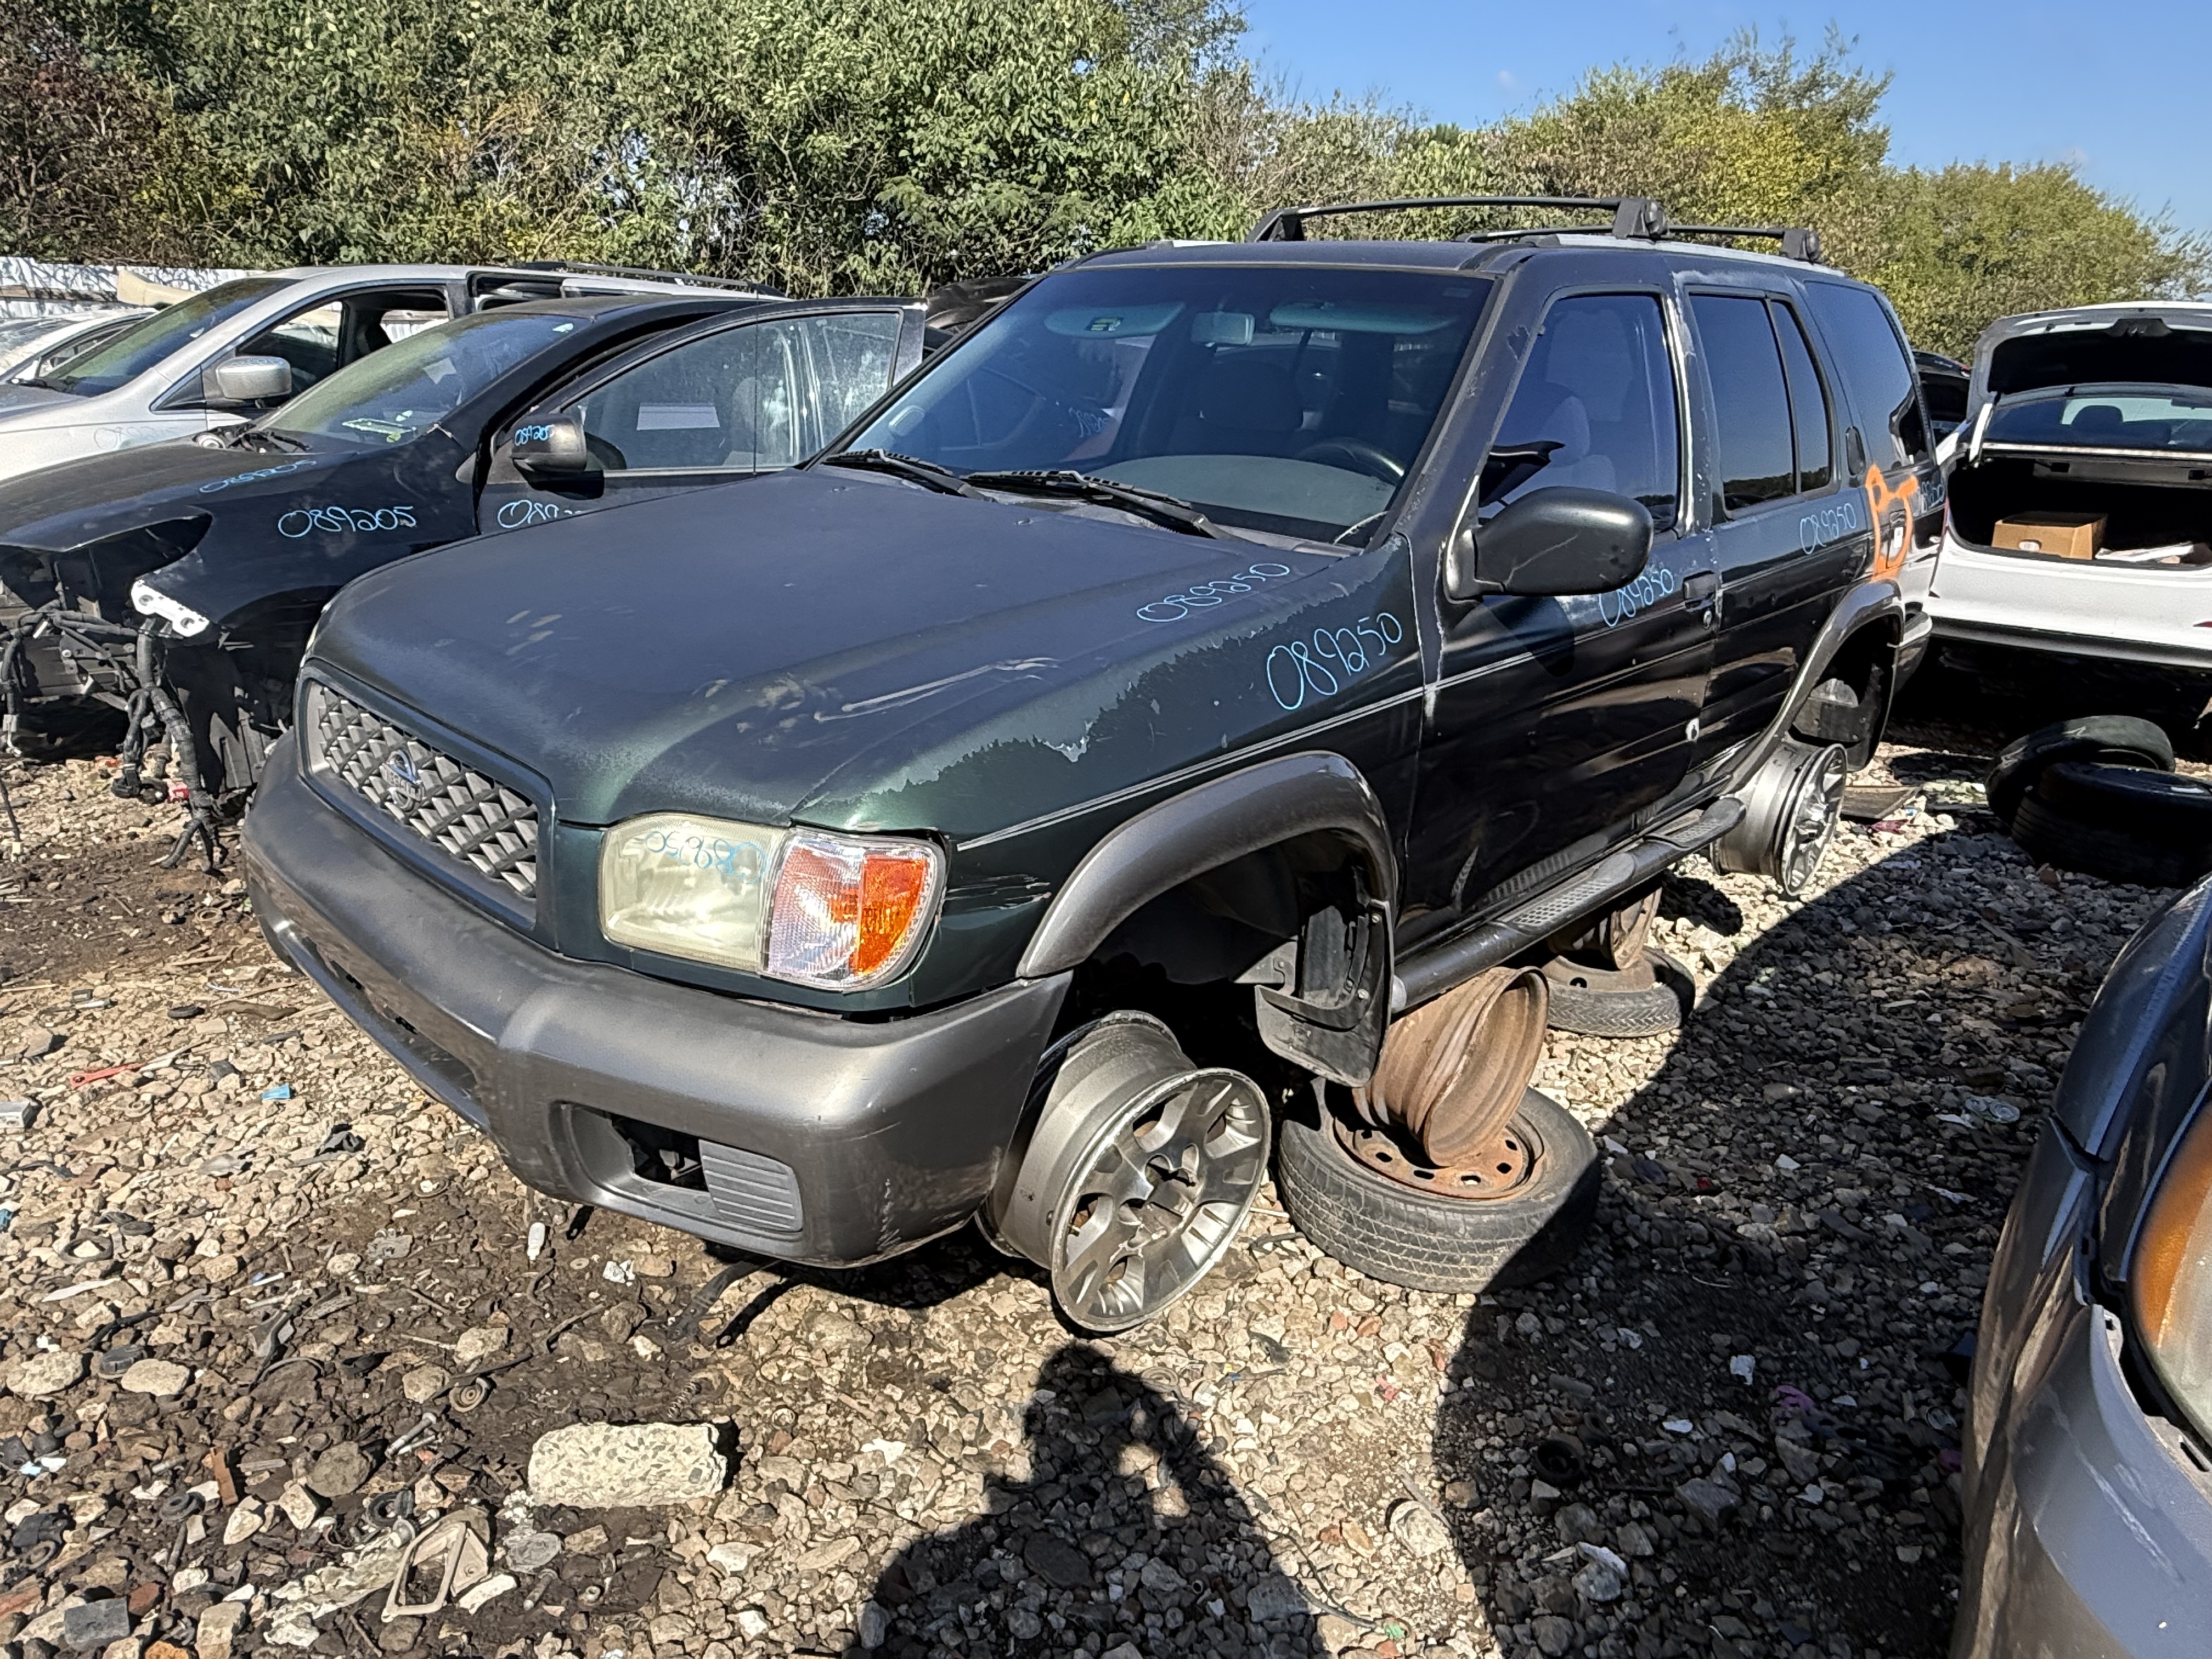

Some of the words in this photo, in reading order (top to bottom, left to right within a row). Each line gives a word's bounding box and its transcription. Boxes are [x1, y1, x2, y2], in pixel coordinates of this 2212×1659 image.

[278, 506, 417, 538] 089205
[1799, 503, 1857, 555] 089250
[1137, 563, 1290, 622] 089250
[1266, 612, 1403, 711] 089250
